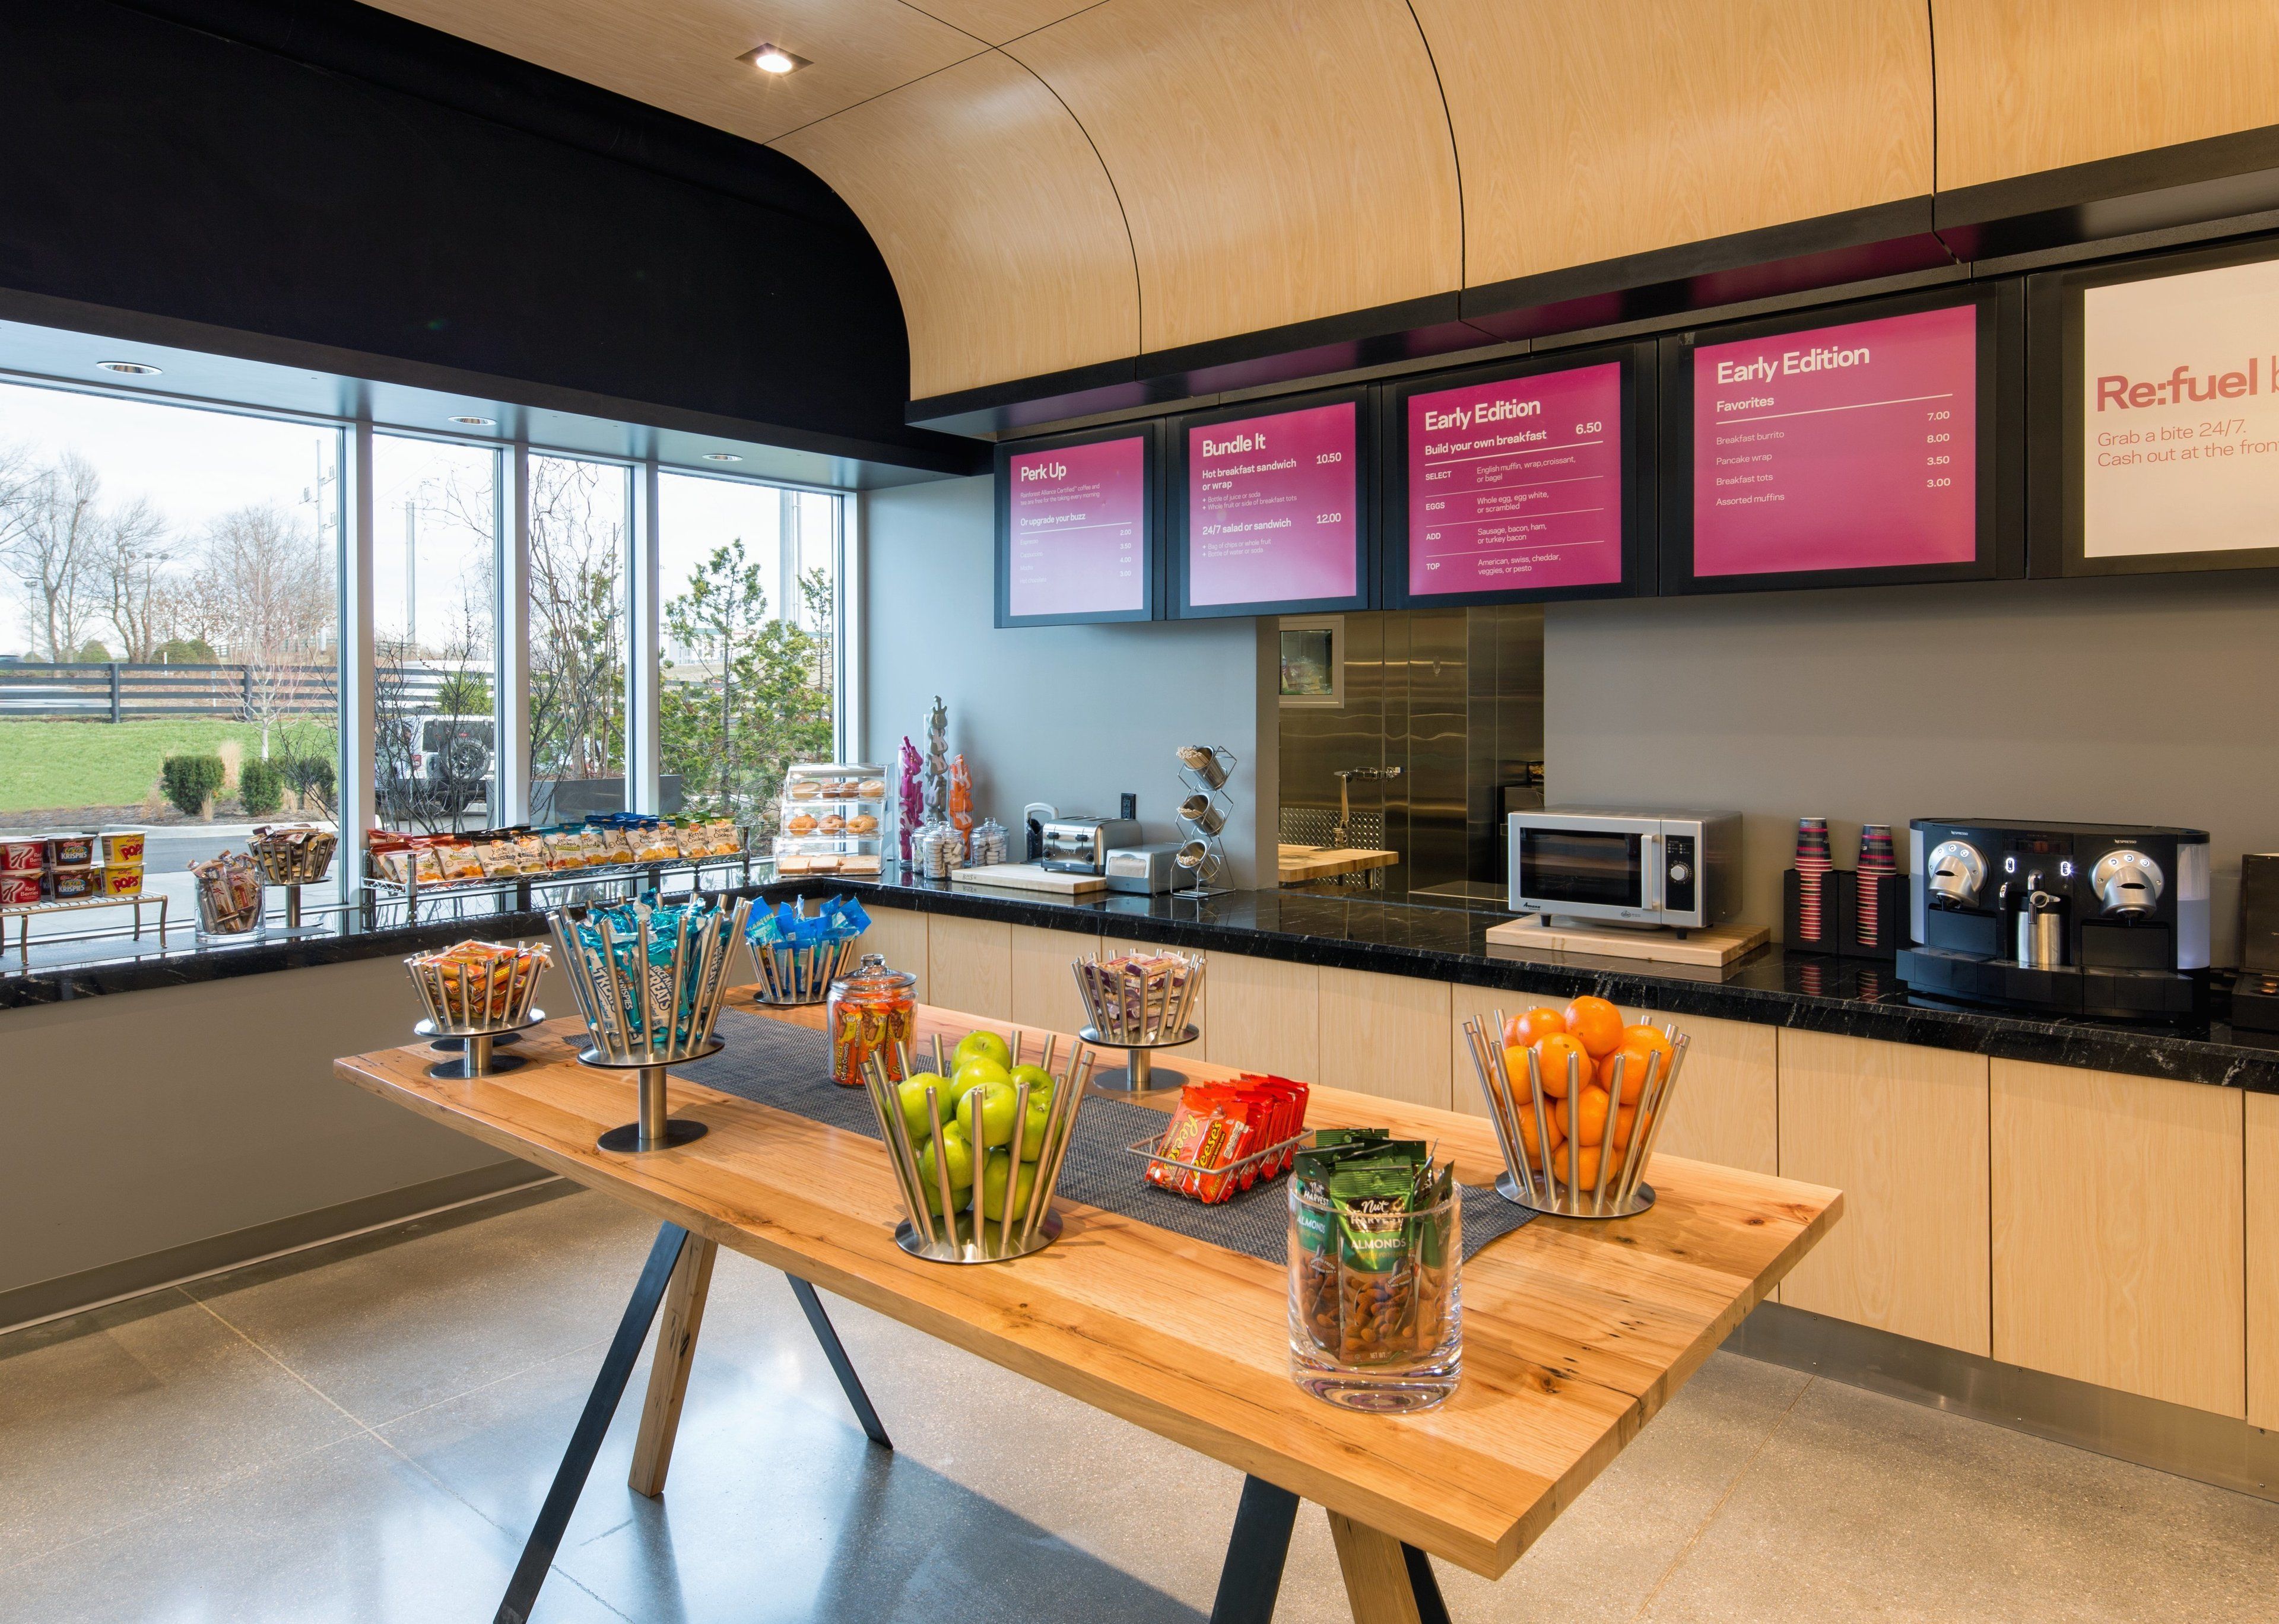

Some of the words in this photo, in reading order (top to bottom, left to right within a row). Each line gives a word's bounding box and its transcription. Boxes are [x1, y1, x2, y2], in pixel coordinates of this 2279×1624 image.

[1717, 356, 1779, 384] Early
[1783, 346, 1870, 376] Edition
[2097, 357, 2258, 412] Re:fuel
[1716, 395, 1775, 412] Favorites
[1425, 406, 1471, 431] Early
[1475, 399, 1541, 423] Edition
[1927, 411, 1950, 422] 7.00
[1576, 421, 1602, 435] 6.50
[2097, 430, 2140, 447] Grab
[2145, 430, 2156, 443] a
[2161, 425, 2194, 441] bite
[2199, 419, 2246, 438] 24/7.
[1425, 444, 1449, 456] Build
[1450, 442, 1472, 454] your
[1474, 438, 1495, 449] own
[1496, 430, 1547, 446] breakfast
[1716, 434, 1756, 445] Breakfast
[1756, 430, 1785, 441] burrito
[1926, 433, 1950, 444] 8.00
[1202, 435, 1252, 457] Bundle
[1255, 433, 1266, 450] It
[1316, 452, 1342, 465] 10.50
[1716, 455, 1750, 466] Pancake
[1751, 453, 1772, 463] wrap
[2097, 449, 2142, 467] Cash
[2147, 447, 2176, 463] out
[2181, 446, 2199, 460] at
[2204, 442, 2234, 458] the
[2239, 439, 2279, 455] fron
[1926, 455, 1950, 466] 3.50
[1021, 463, 1048, 482] Perk
[1049, 462, 1067, 481] Up
[1202, 469, 1216, 479] Hot
[1217, 464, 1255, 477] breakfast
[1256, 458, 1297, 472] sandwich
[1477, 465, 1500, 475] English
[1500, 462, 1522, 472] muffin,
[1425, 471, 1452, 481] SELECT
[1485, 473, 1503, 482] bagel
[1716, 475, 1755, 486] Breakfast
[1757, 473, 1773, 482] tots
[1926, 477, 1951, 488] 3.00
[1077, 484, 1091, 492] coffee
[1212, 480, 1233, 490] wrap
[1082, 491, 1100, 500] morning
[1229, 493, 1242, 501] juice
[1477, 497, 1497, 505] Whole
[1528, 491, 1549, 500] white,
[1716, 495, 1753, 506] Assorted
[1754, 492, 1785, 503] muffins
[1208, 502, 1223, 511] Whole
[1259, 496, 1285, 505] breakfast
[1426, 502, 1445, 510] EGGS
[1485, 503, 1520, 513] scrambled
[1020, 518, 1029, 526] Or
[1029, 515, 1055, 526] upgrade
[1055, 515, 1070, 525] your
[1070, 513, 1086, 521] buzz
[1316, 513, 1341, 525] 12.00
[1202, 525, 1221, 535] 24/7
[1222, 523, 1243, 533] salad
[1253, 517, 1291, 530] sandwich
[1477, 527, 1507, 536] Sausage,
[1530, 523, 1547, 531] ham,
[1426, 532, 1441, 541] ADD
[1485, 535, 1506, 544] turkey
[1208, 543, 1218, 551] Bag
[1224, 541, 1238, 549] chips
[1478, 558, 1509, 567] American,
[1532, 554, 1561, 562] cheddar,
[1478, 568, 1504, 576] veggies,
[1513, 565, 1532, 573] pesto
[1208, 1156, 1217, 1169] PEANUT
[1214, 1143, 1222, 1157] BUTTER
[1309, 1181, 1325, 1196] Nut
[1304, 1190, 1329, 1207] HARVEST
[1361, 1199, 1389, 1213] Nut
[1297, 1215, 1326, 1234] ALMONDS
[1351, 1238, 1407, 1250] ALMONDS
